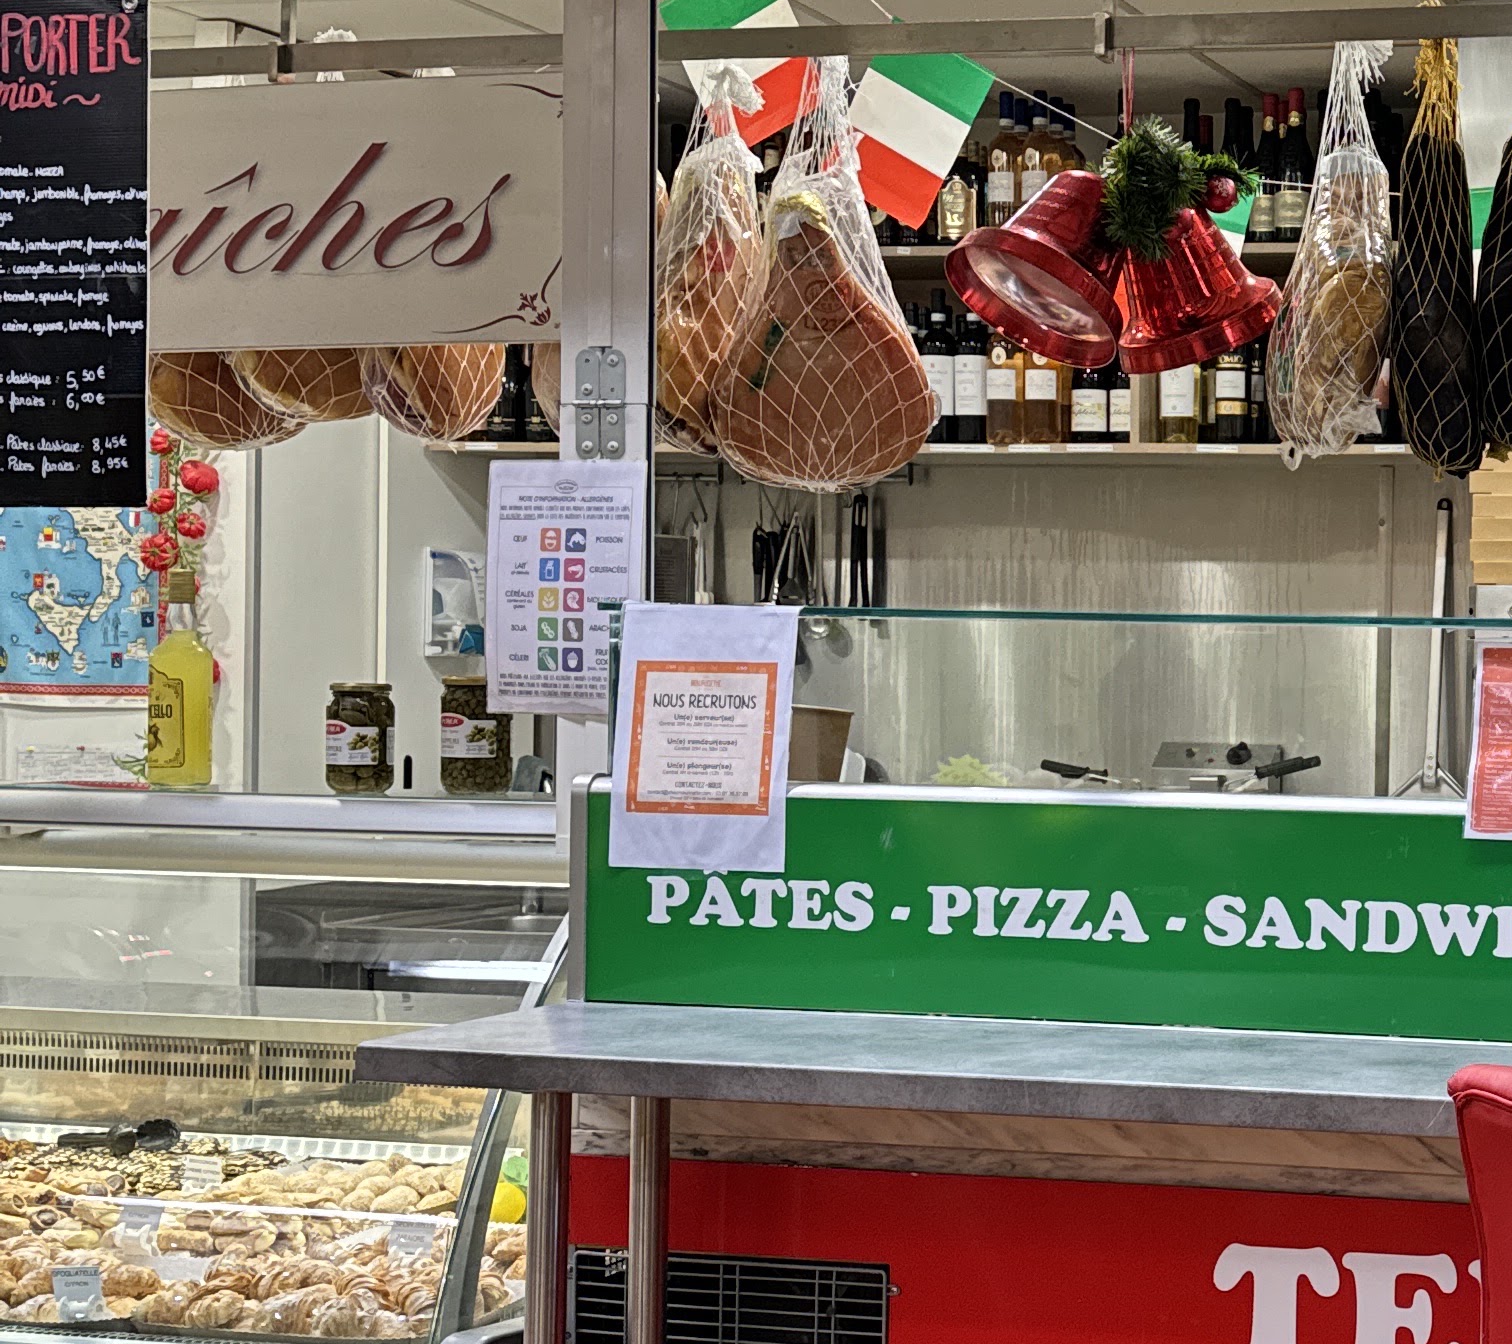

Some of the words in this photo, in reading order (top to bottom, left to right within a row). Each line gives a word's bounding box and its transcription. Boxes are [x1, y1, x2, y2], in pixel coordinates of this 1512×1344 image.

[652, 693, 686, 709] NOUS
[688, 693, 758, 710] RECRUTONS
[646, 869, 874, 932] PÂTES
[927, 885, 1150, 943] PIZZA
